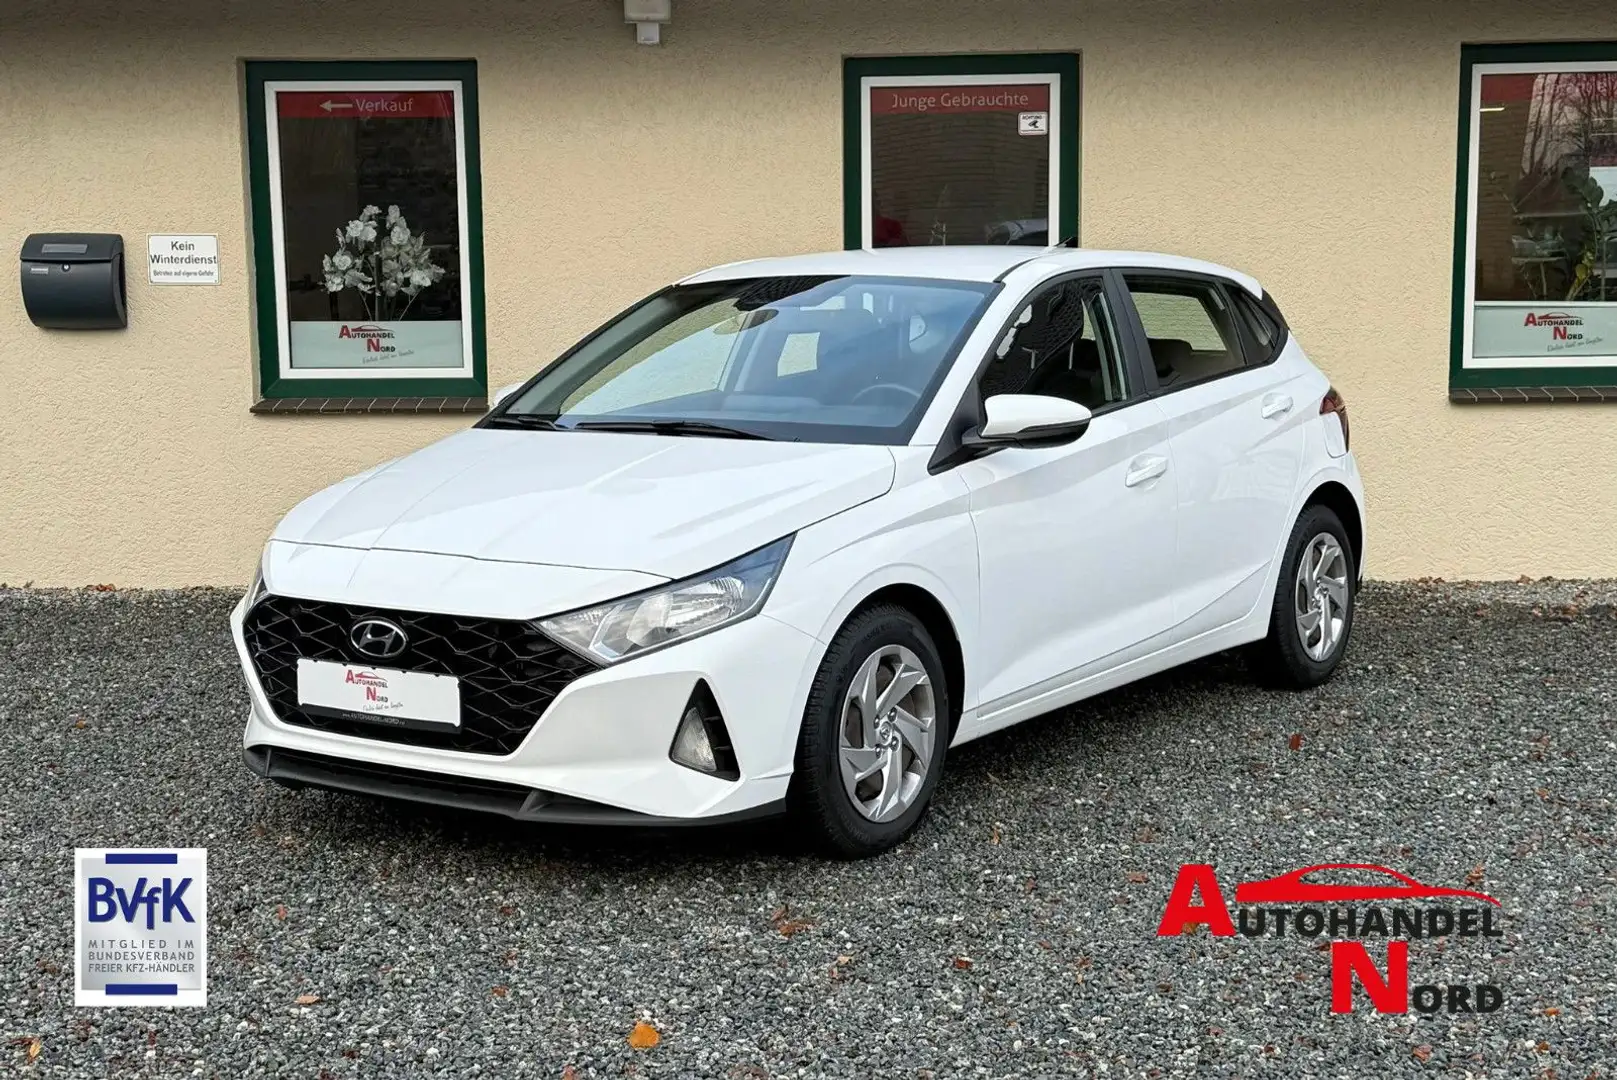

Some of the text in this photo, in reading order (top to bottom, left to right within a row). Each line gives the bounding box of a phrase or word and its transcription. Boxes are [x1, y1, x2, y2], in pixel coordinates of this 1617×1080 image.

[355, 98, 413, 112] Verkauf
[892, 92, 1029, 111] Junge Gebrauchte
[171, 241, 195, 251] Kein
[150, 254, 217, 264] Winterdienst
[1524, 313, 1583, 326] AUTOHANDEL
[339, 325, 395, 338] AUTOHANDEL
[1553, 326, 1583, 340] NORD
[367, 339, 395, 352] NORD
